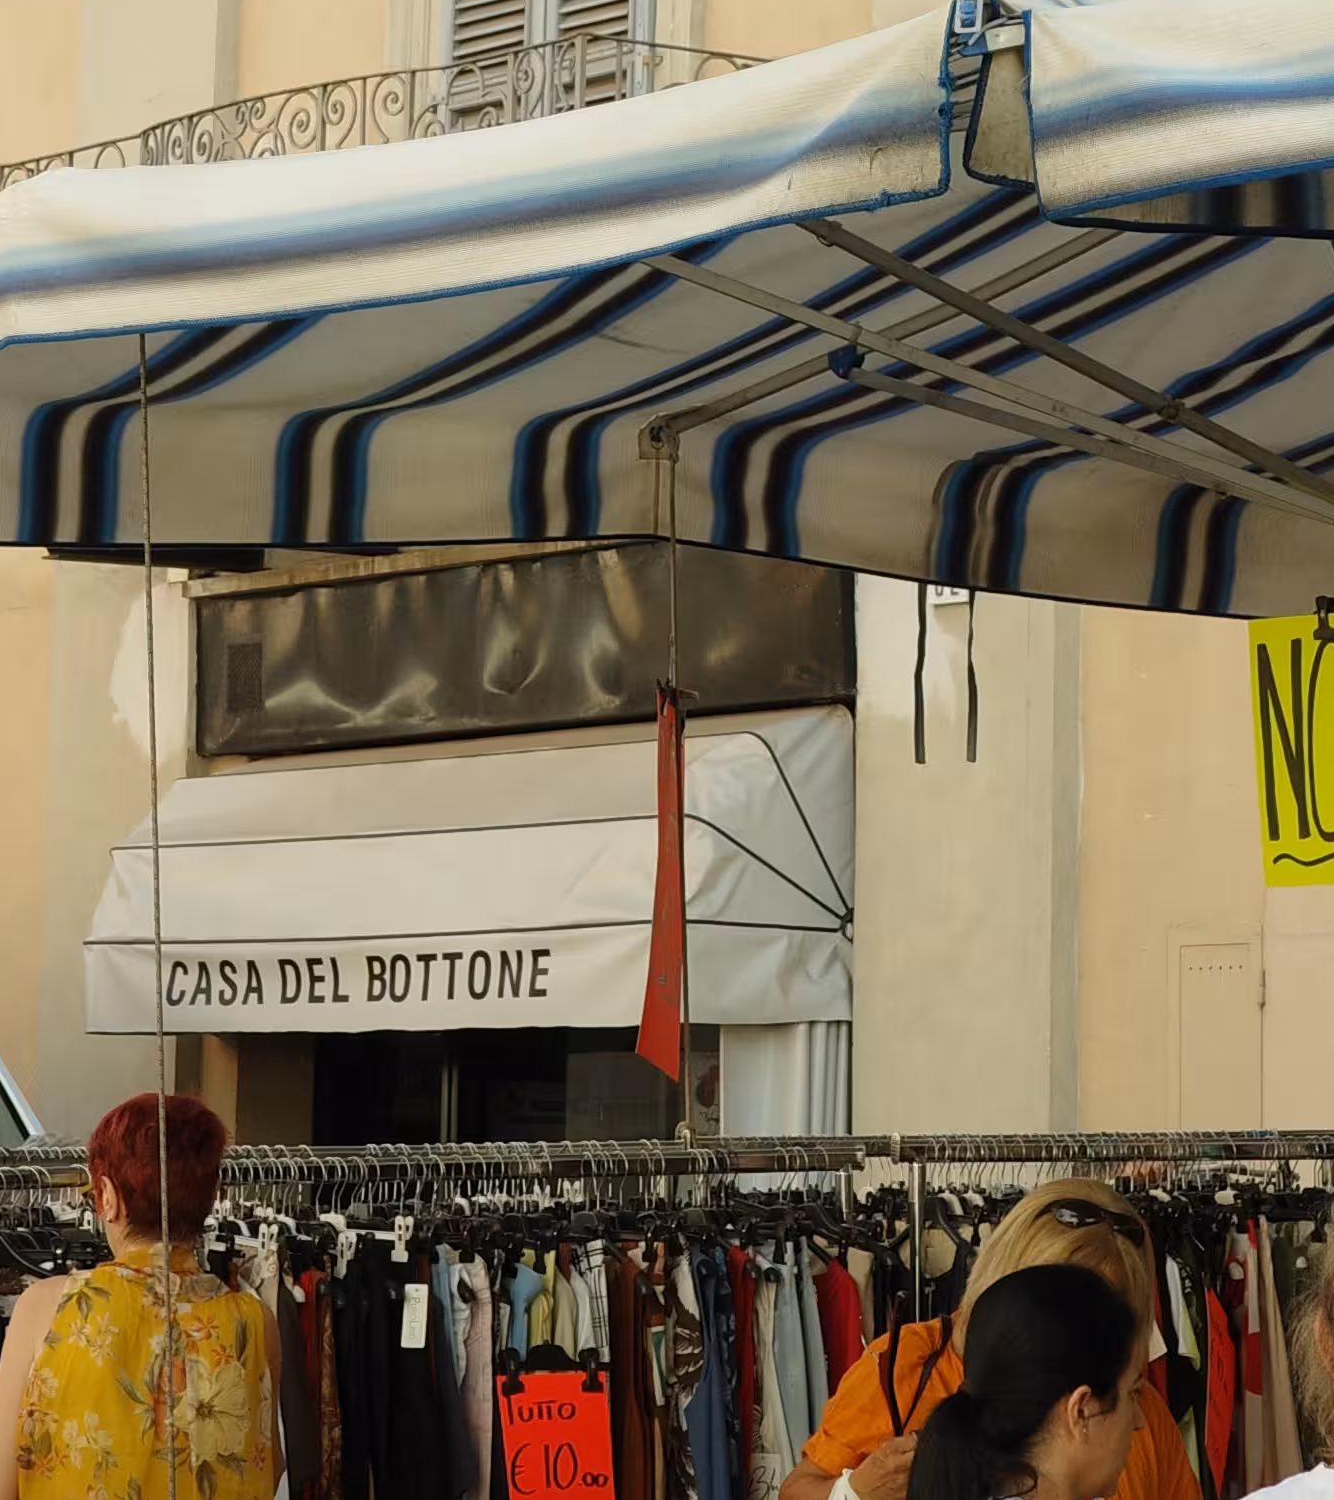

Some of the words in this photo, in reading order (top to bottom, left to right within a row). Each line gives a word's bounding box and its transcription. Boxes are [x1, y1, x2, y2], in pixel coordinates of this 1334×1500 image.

[167, 959, 265, 1006] CASA
[278, 956, 350, 1004] DEL
[365, 948, 551, 1003] BOTTONE
